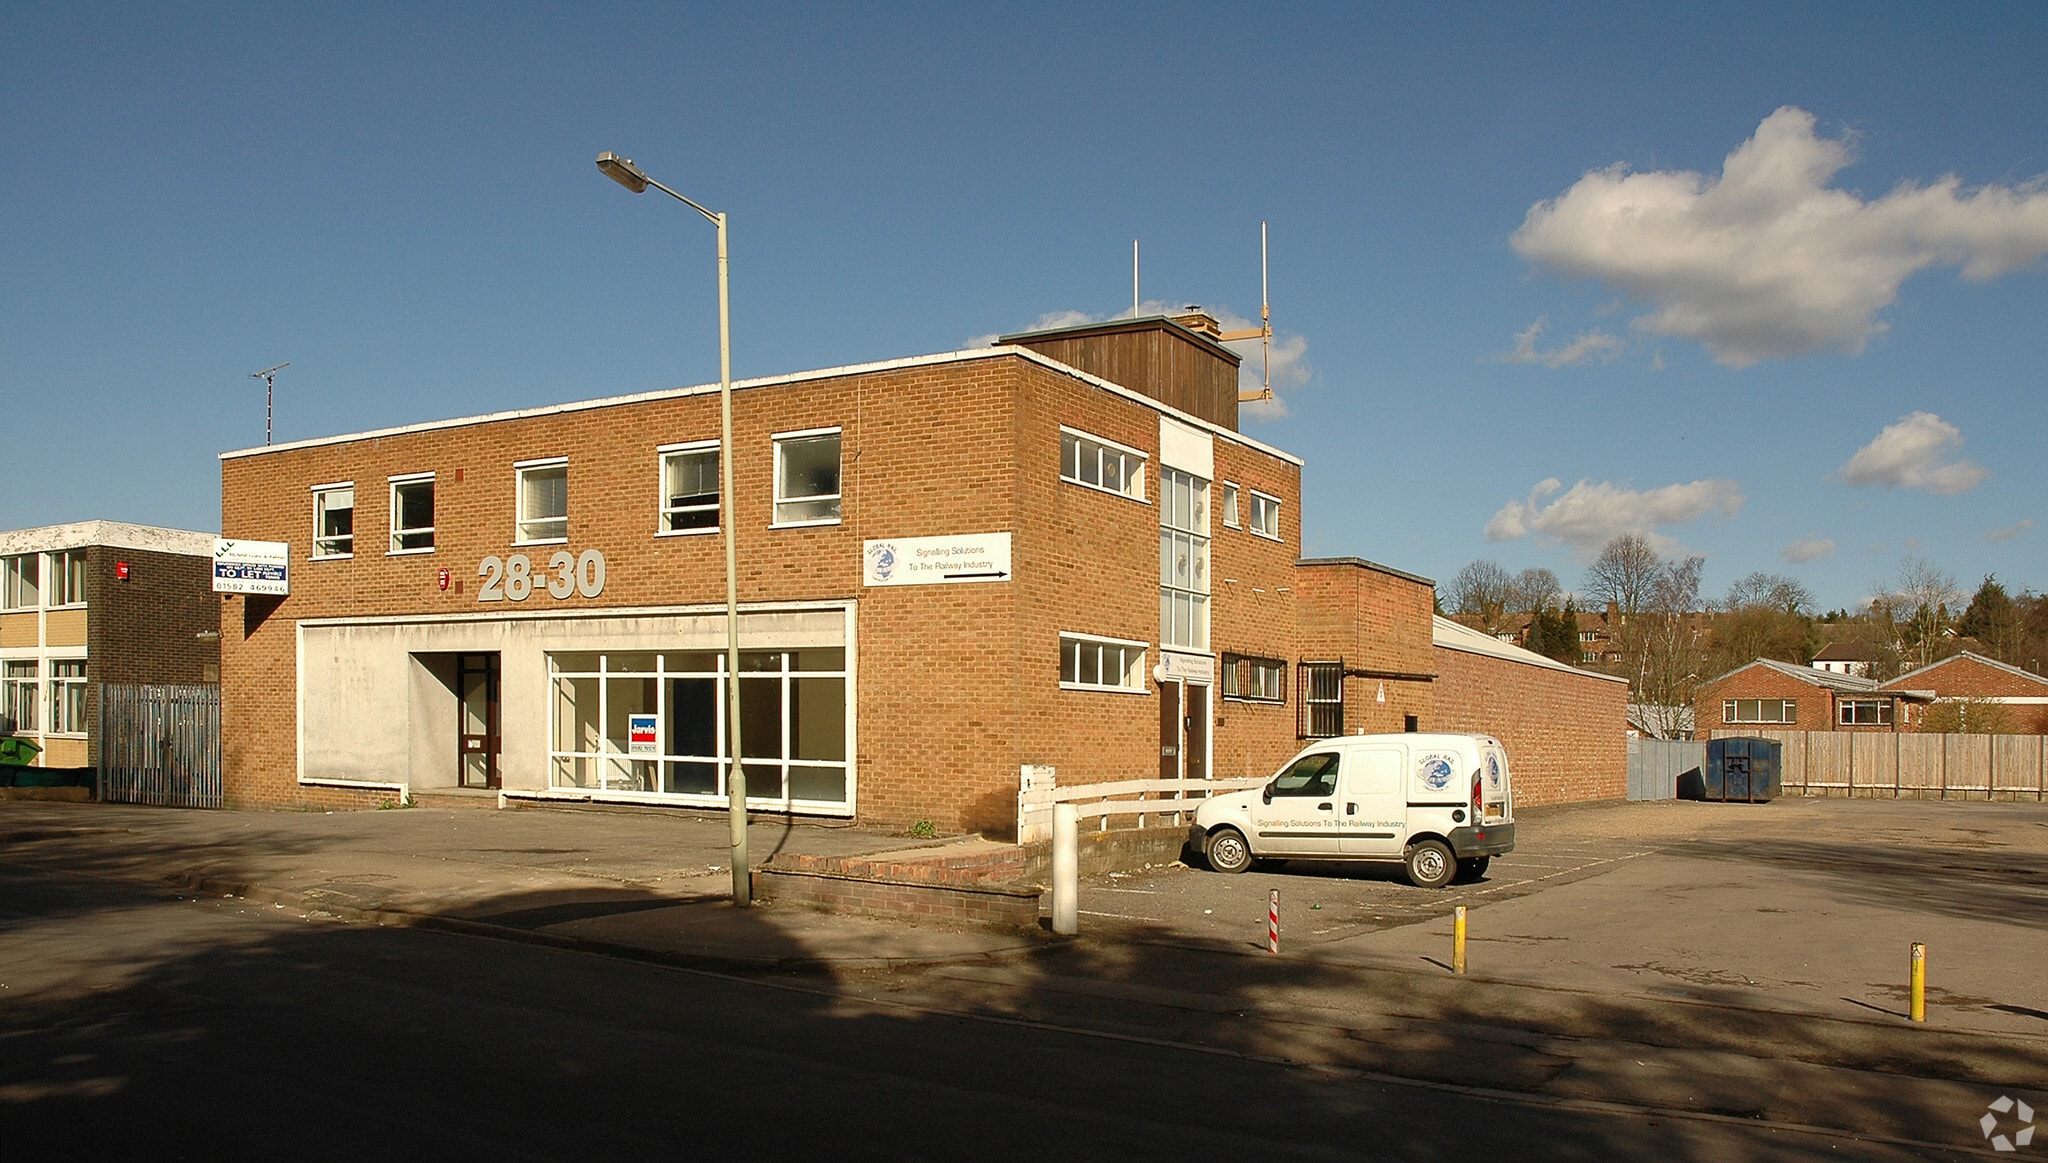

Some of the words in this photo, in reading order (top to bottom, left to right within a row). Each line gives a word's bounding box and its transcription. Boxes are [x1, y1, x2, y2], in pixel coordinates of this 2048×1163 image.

[916, 548, 950, 558] Signalling
[951, 546, 985, 555] Solutions
[909, 563, 918, 571] To
[920, 562, 933, 571] The
[935, 562, 962, 571] Railway
[963, 560, 993, 570] Industry
[219, 568, 237, 578] TO
[241, 569, 262, 579] LET
[478, 549, 606, 602] 28-30
[216, 582, 243, 591] 01582
[250, 584, 285, 592] 469946
[632, 724, 656, 735] Jarvis
[1257, 819, 1289, 828] Signalling
[1290, 819, 1322, 828] Solutions
[1323, 819, 1333, 827] To
[1334, 819, 1347, 827] The
[1348, 819, 1376, 828] Railway
[1376, 819, 1407, 829] Industry
